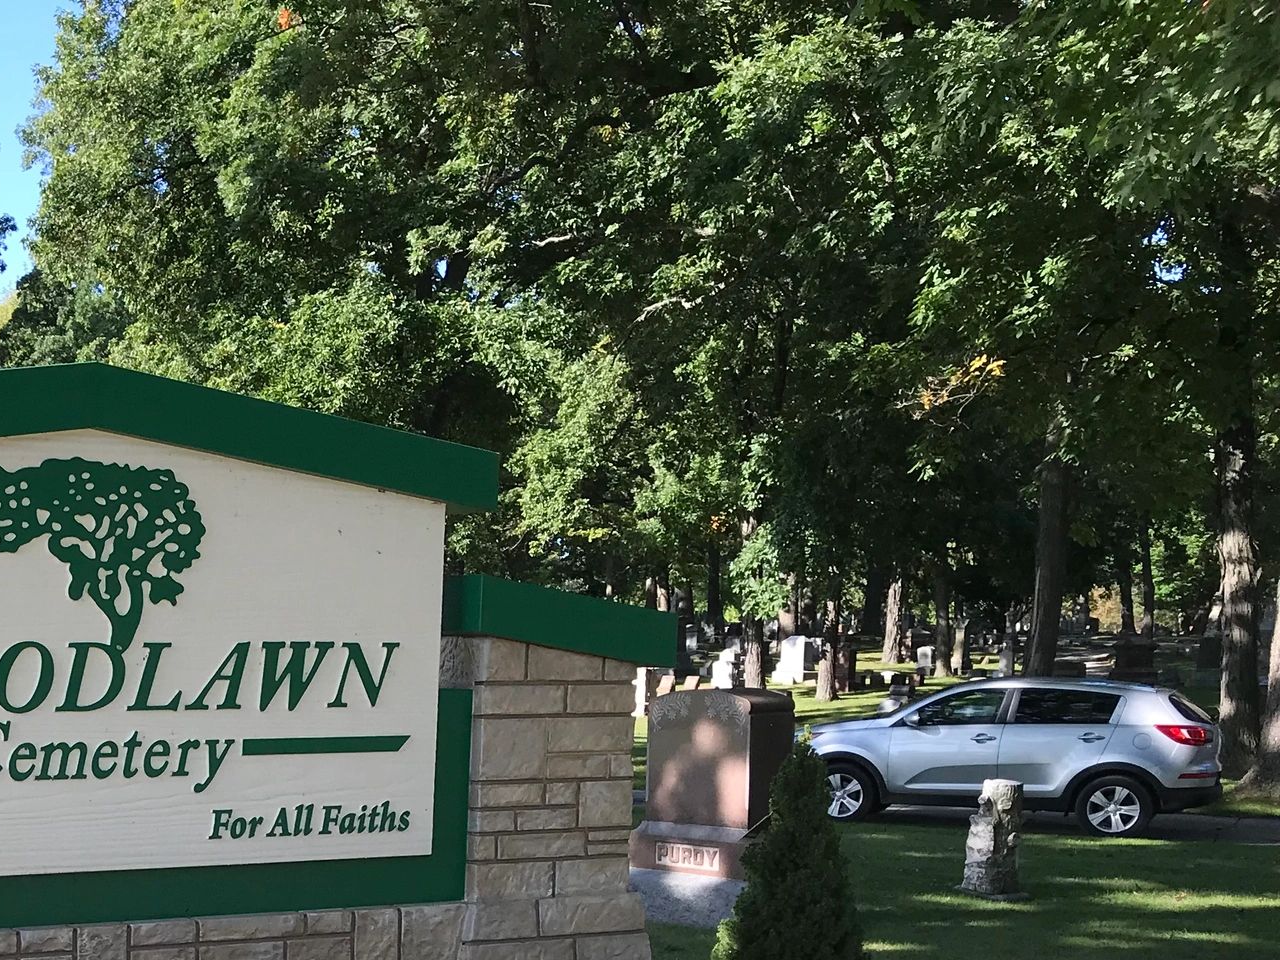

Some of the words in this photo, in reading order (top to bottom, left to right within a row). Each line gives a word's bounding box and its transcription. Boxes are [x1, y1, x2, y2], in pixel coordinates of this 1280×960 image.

[209, 809, 264, 840] For
[265, 804, 314, 838] All
[318, 801, 410, 835] Faiths
[657, 844, 718, 867] PURDY
